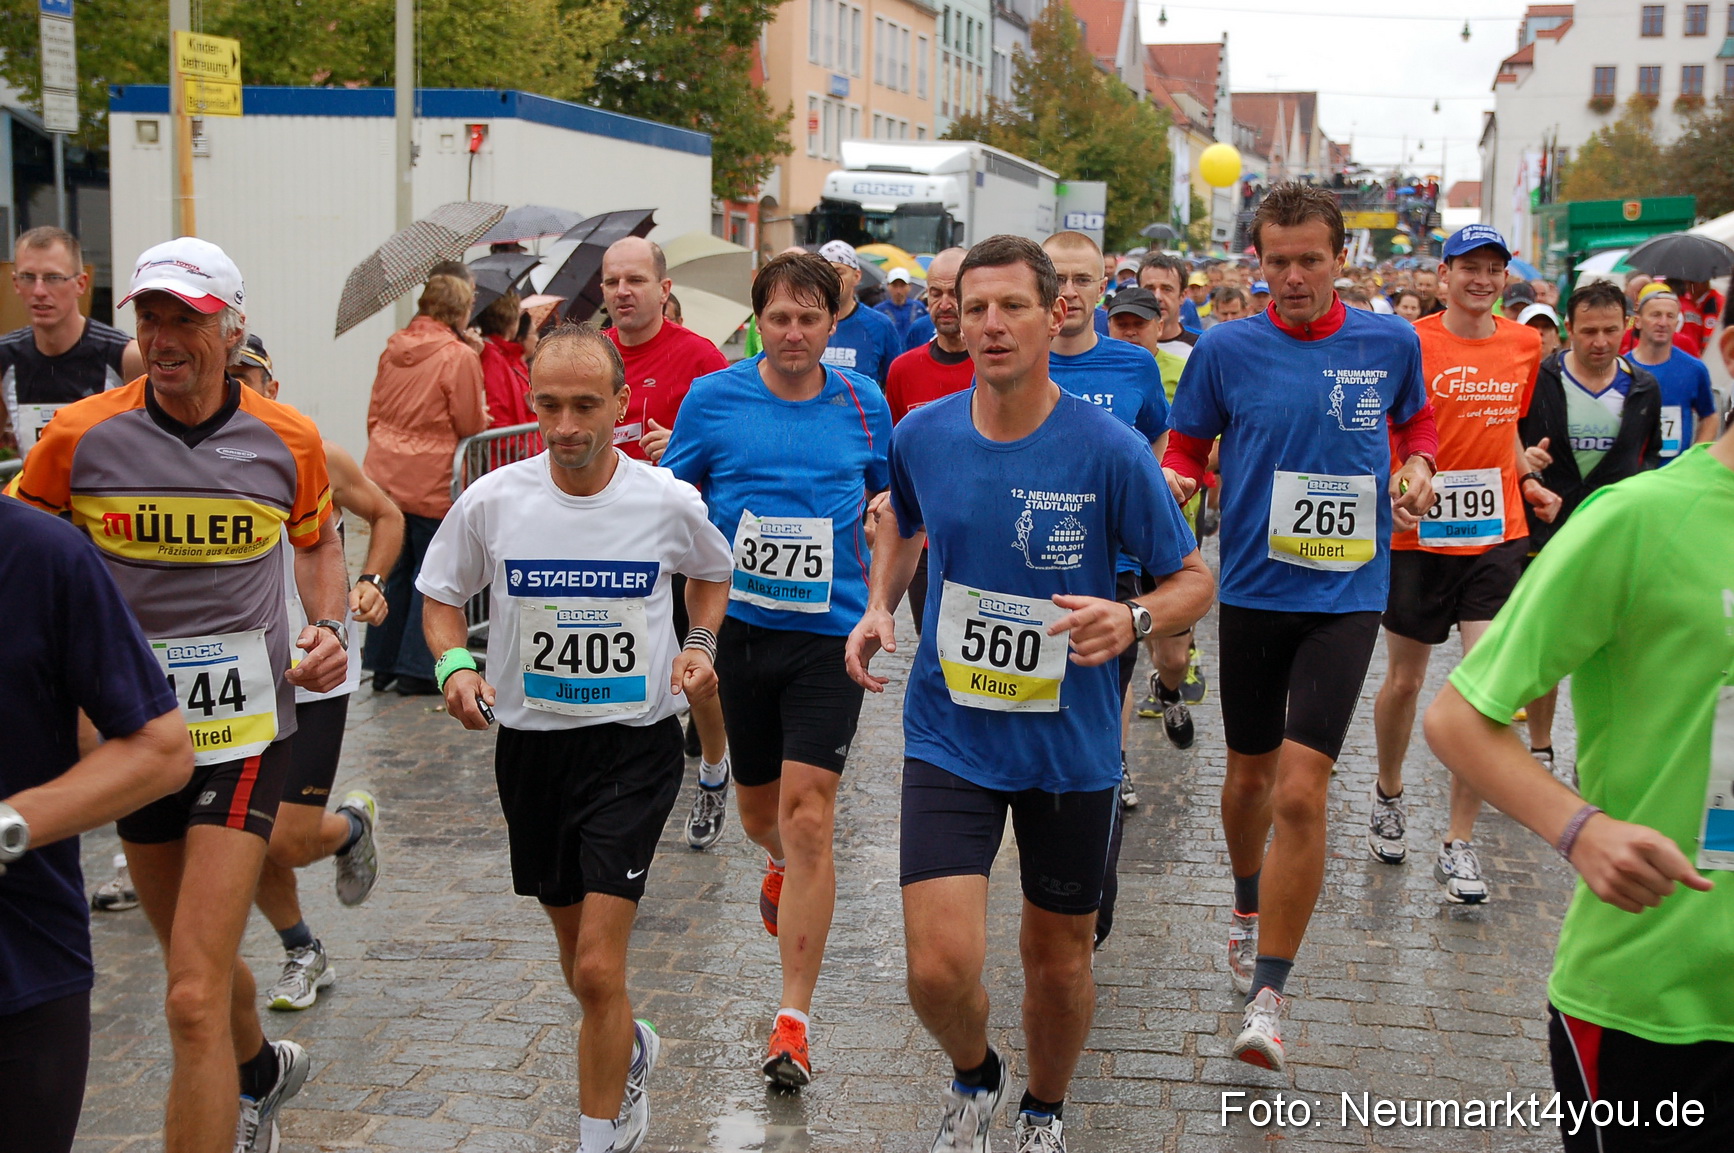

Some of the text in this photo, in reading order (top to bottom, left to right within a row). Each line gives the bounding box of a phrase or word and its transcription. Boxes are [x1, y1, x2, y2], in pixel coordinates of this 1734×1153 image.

[853, 182, 915, 197] BOCK
[176, 260, 200, 271] TOYOTA
[822, 346, 857, 361] BER
[1322, 369, 1388, 379] 12. NEUMARKTER
[1335, 377, 1379, 385] STADTLAUF
[1449, 376, 1519, 394] Fischer
[1081, 393, 1114, 406] AST
[1456, 394, 1514, 402] AUTOMOBILE
[1662, 420, 1675, 438] 7
[1307, 480, 1350, 491] BOCK
[1444, 474, 1478, 484] BOCK
[1011, 488, 1096, 503] 12. NEUMARKTER
[1025, 499, 1083, 512] STADTLAUF
[1292, 499, 1357, 536] 265
[761, 523, 802, 534] BOCK
[1446, 525, 1478, 536] David
[158, 545, 203, 557] Präzision
[205, 546, 222, 556] aus
[1046, 543, 1084, 552] 18.09.2011
[1299, 542, 1345, 558] Hubert
[741, 537, 823, 578] 3275
[747, 578, 812, 599] Alexander
[557, 609, 609, 621] BOCK
[978, 598, 1031, 617] BOCK
[167, 642, 224, 660] BOCK
[532, 631, 636, 674] 2403
[961, 618, 1041, 673] 560
[970, 672, 1018, 697] Klaus
[556, 683, 611, 702] Jürgen
[189, 725, 233, 748] lfred
